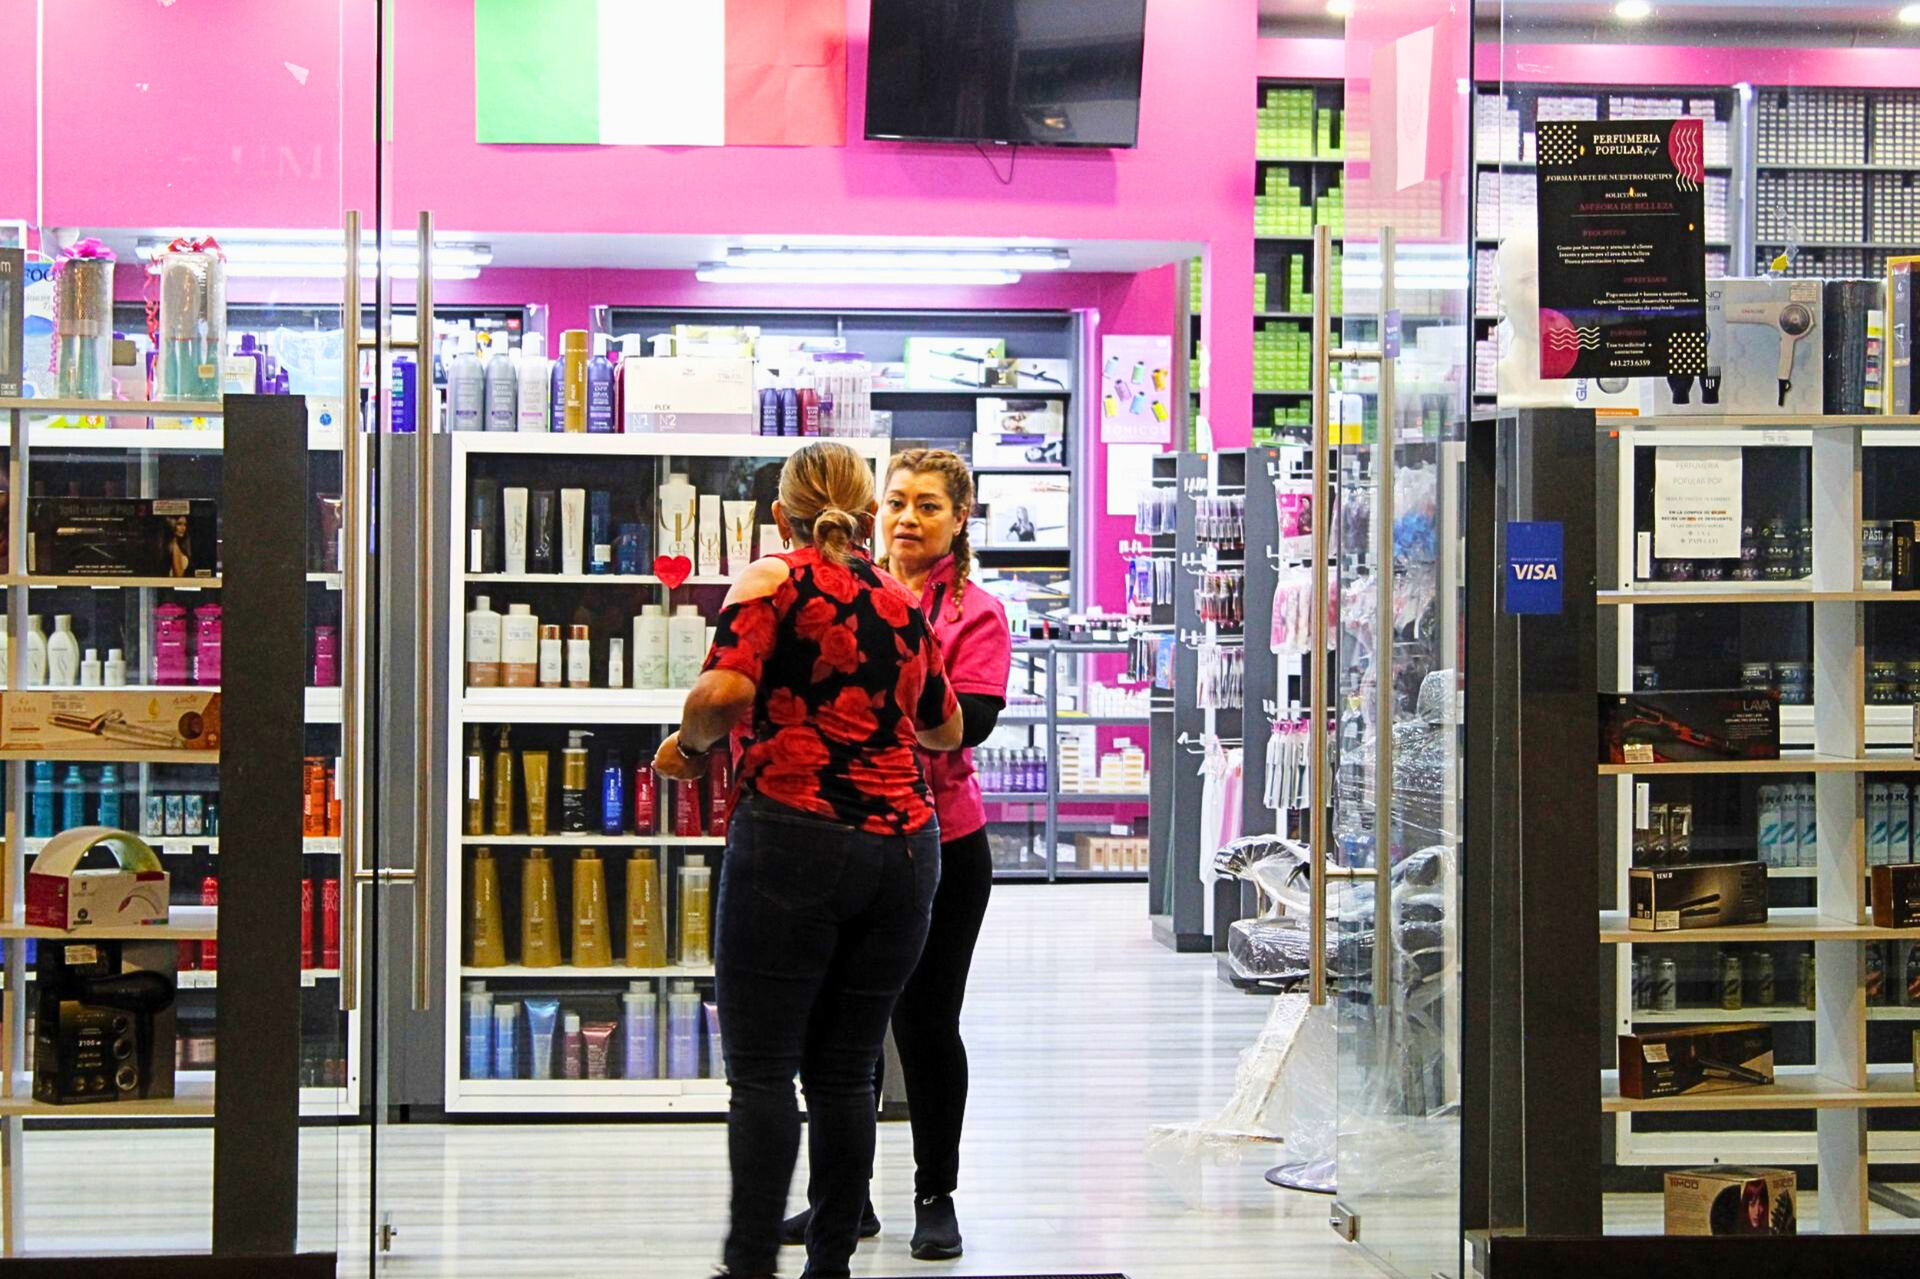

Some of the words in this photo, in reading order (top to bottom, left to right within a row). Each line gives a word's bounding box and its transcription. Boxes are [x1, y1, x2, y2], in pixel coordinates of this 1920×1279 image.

[1593, 134, 1661, 144] PERFUMERIA
[1595, 145, 1643, 155] POPULAR
[1579, 202, 1618, 211] ASESORA
[1635, 202, 1674, 210] BELLEZA
[1511, 564, 1557, 580] VISA
